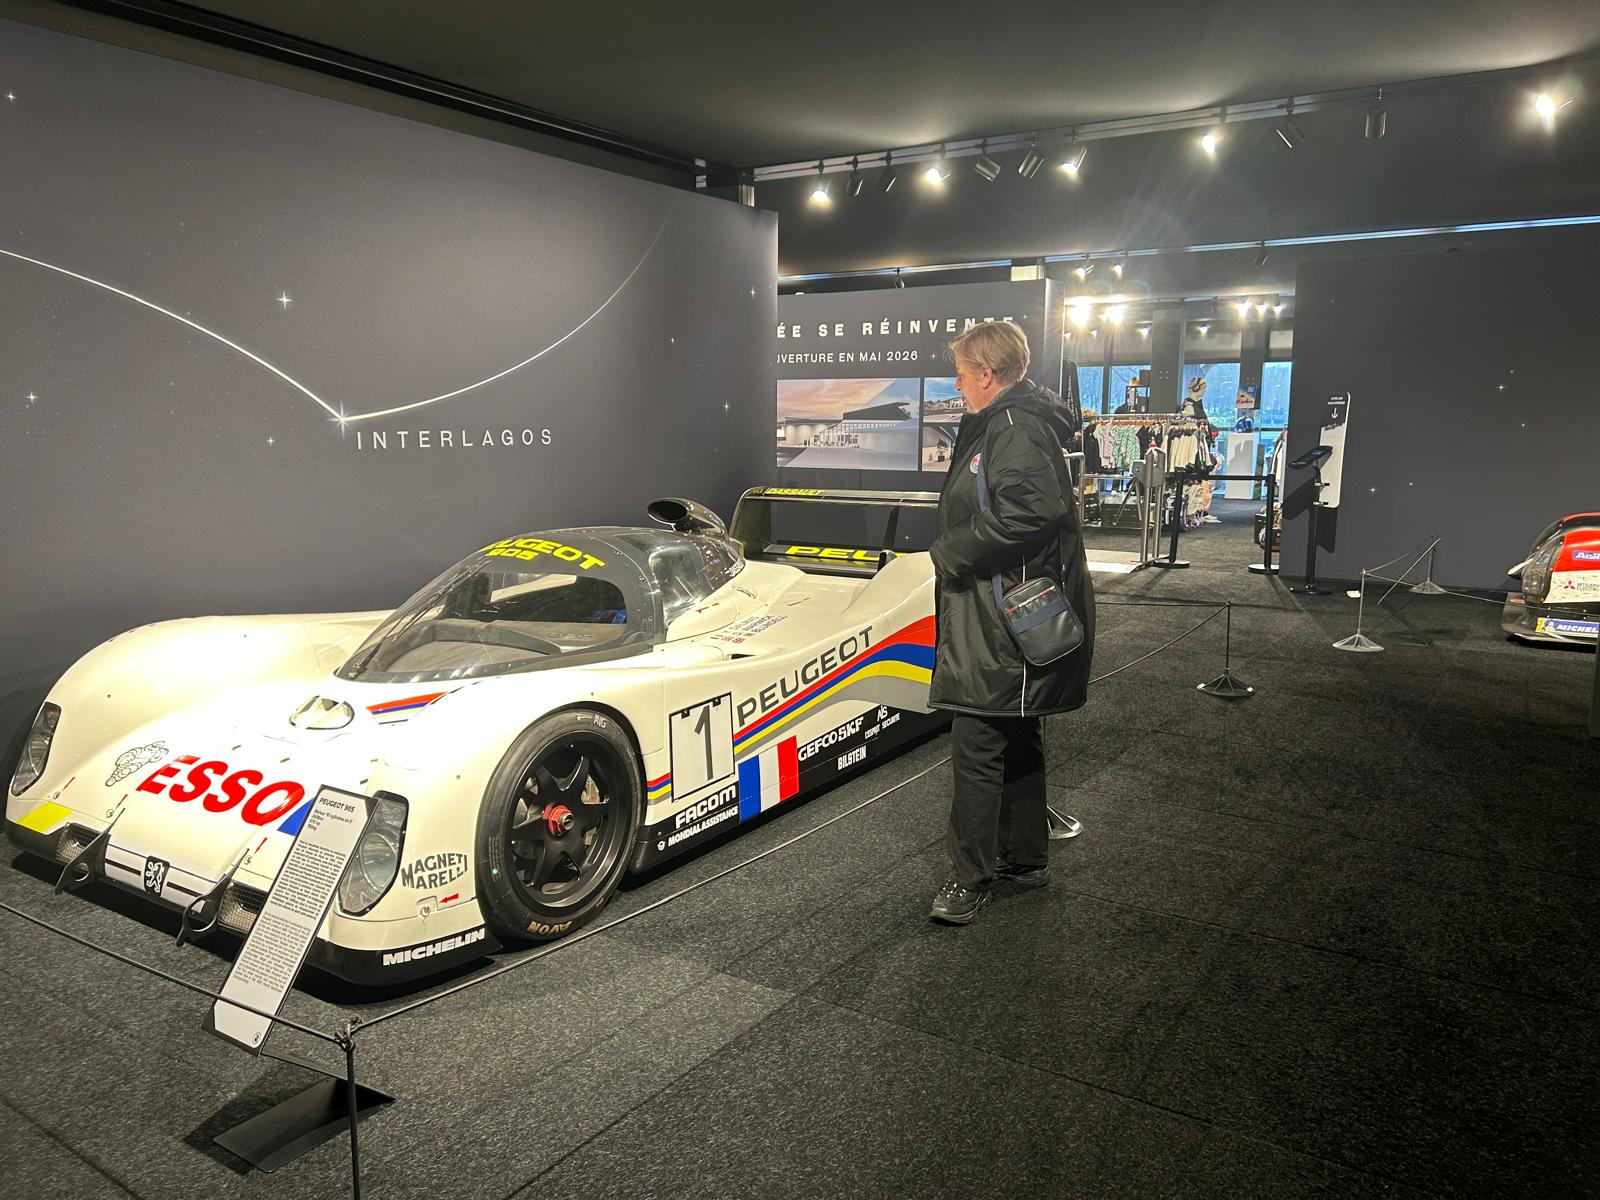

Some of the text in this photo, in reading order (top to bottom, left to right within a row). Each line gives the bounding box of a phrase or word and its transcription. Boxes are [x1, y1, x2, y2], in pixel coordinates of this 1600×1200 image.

[818, 323, 844, 337] SE
[839, 352, 854, 362] EN
[859, 351, 881, 362] MAI
[886, 350, 918, 361] 2026
[356, 428, 551, 450] INTERLAGOS
[766, 487, 825, 496] DASSAULT
[485, 548, 539, 560] 905
[736, 625, 873, 727] PEUGEOT
[838, 716, 864, 742] SKF
[693, 704, 714, 781] 1
[798, 731, 838, 762] GEFCO
[837, 745, 867, 771] BILSTEIN
[136, 755, 305, 826] ESSO
[319, 798, 344, 809] PEUGEOT
[668, 805, 739, 847] MONDIAL ASSISTANCE
[527, 920, 573, 937] AVON
[383, 928, 485, 966] MICHELIN
